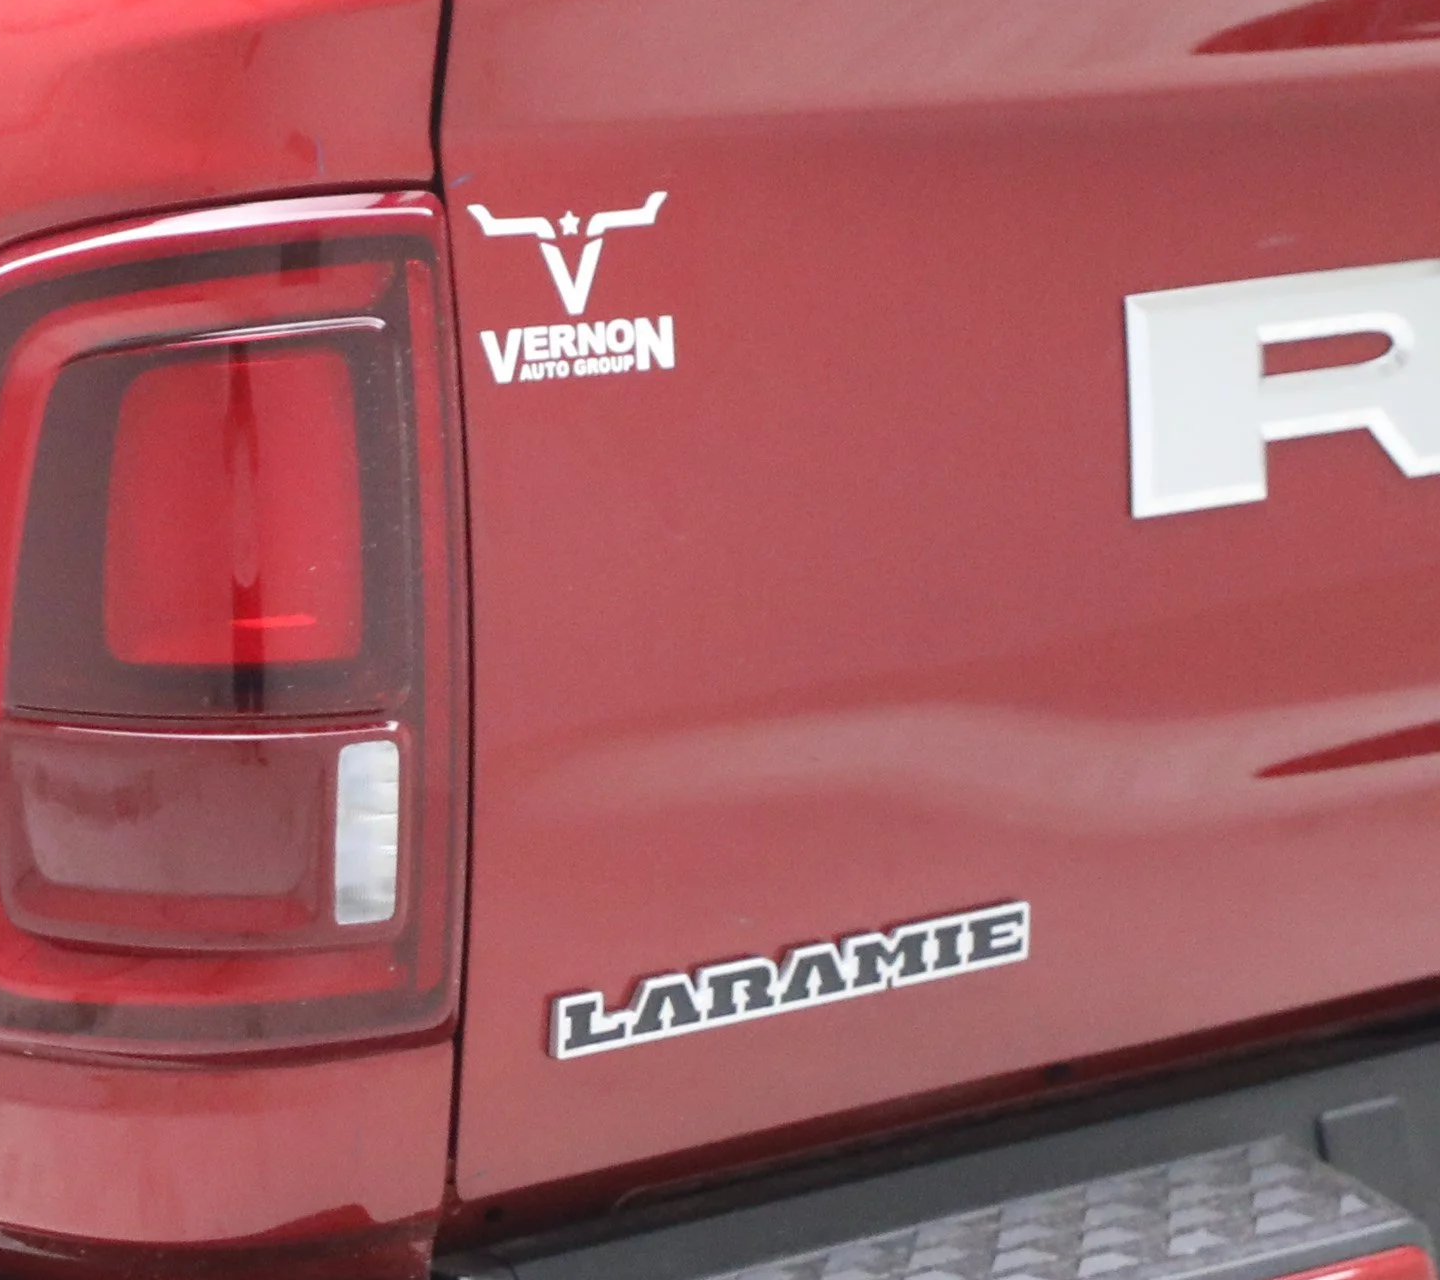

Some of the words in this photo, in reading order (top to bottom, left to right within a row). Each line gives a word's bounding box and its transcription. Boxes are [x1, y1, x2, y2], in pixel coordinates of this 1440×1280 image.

[480, 315, 675, 384] VERNON
[519, 361, 569, 382] AUTO
[573, 354, 635, 376] GROUP
[550, 901, 1030, 1060] LARAMIE
